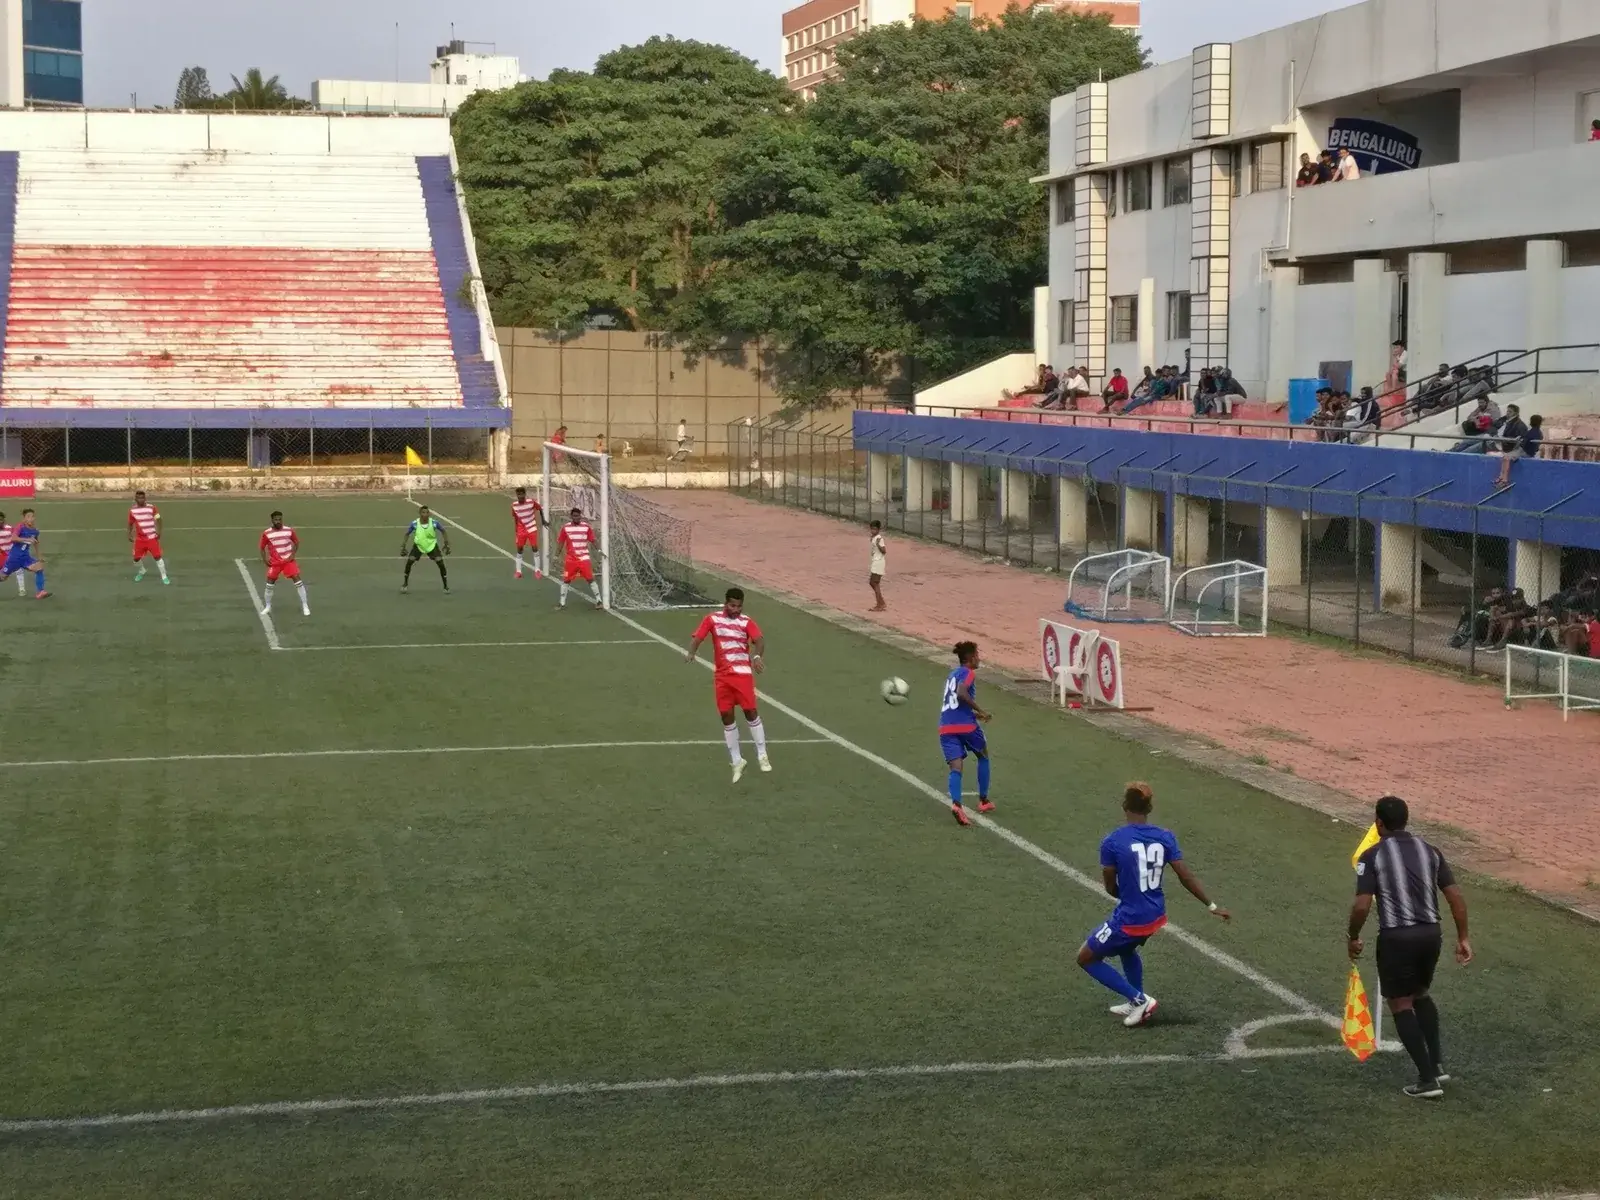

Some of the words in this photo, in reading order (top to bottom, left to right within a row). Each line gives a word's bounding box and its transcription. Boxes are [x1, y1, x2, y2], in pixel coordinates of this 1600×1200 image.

[1329, 129, 1417, 165] BENGALURU
[1131, 842, 1165, 893] 13
[1095, 922, 1112, 944] 13
